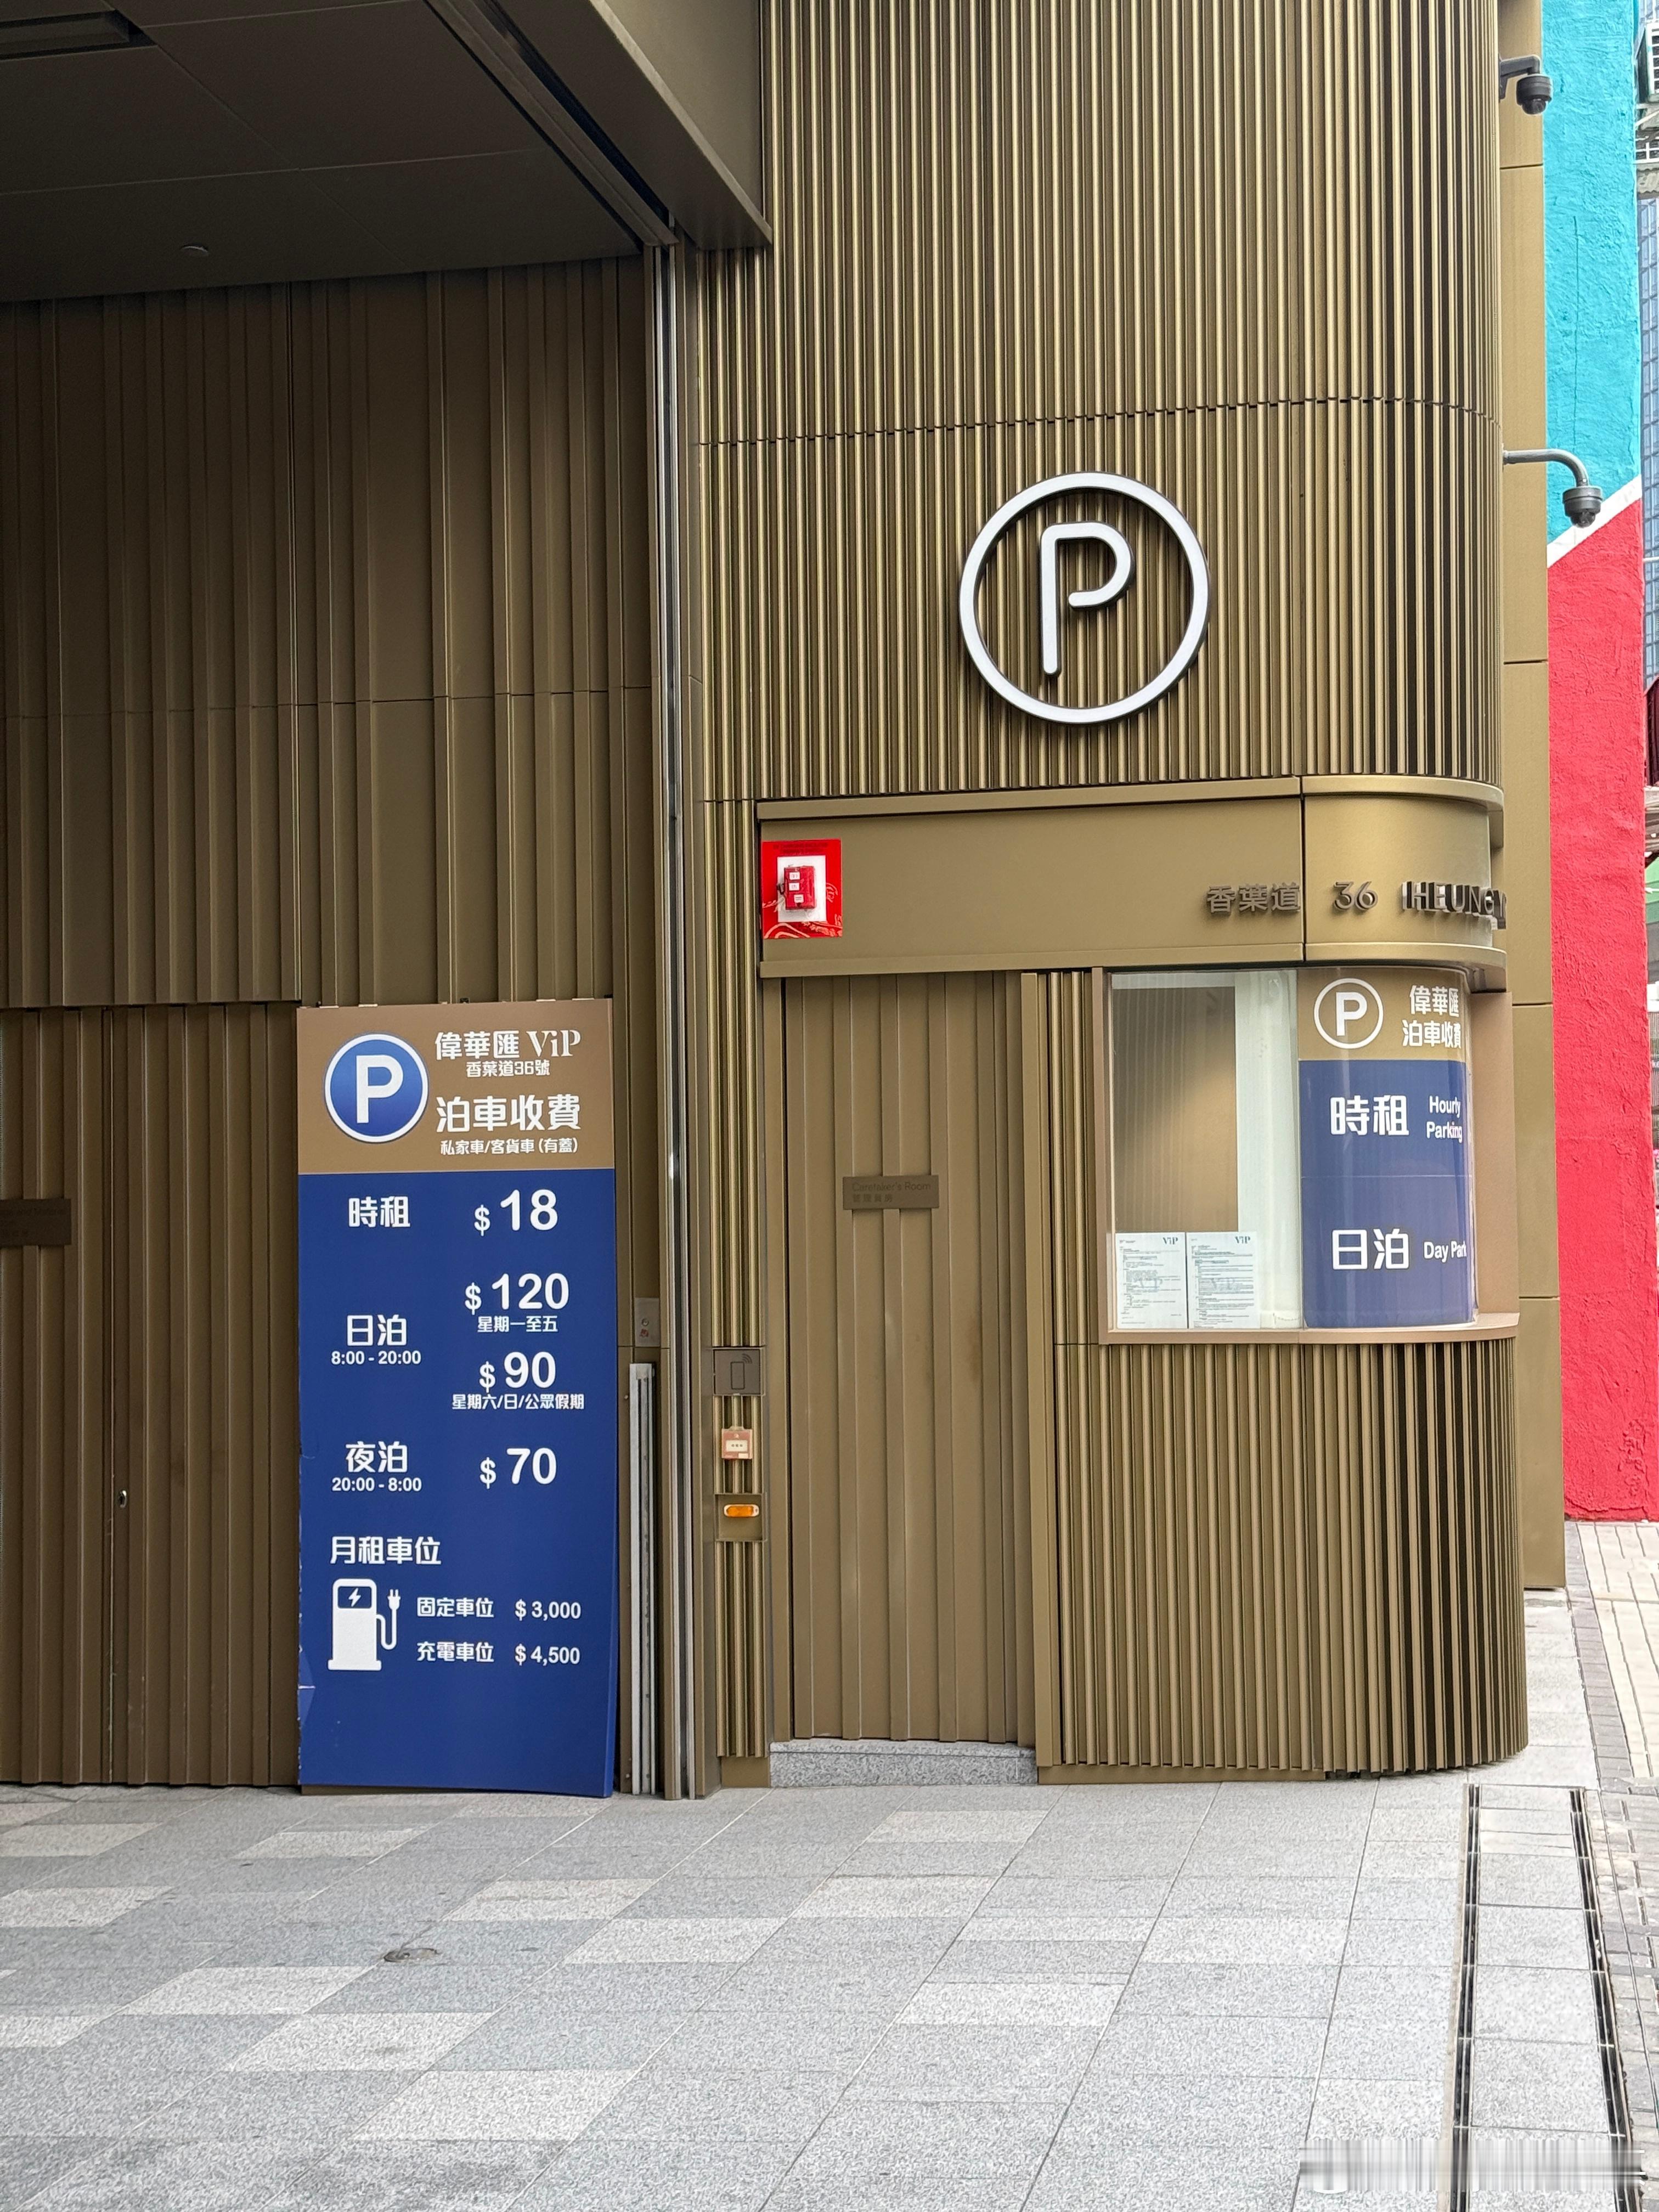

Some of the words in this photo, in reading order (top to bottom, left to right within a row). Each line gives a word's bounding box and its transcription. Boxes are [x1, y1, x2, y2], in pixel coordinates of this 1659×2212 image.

[1207, 882, 1300, 912] 香葉道
[1334, 881, 1379, 911] 36
[1336, 992, 1367, 1036] P
[1409, 985, 1459, 1017] 偉華匯
[435, 1031, 520, 1060] 偉華匯
[1402, 1020, 1461, 1048] 泊車收費
[466, 1059, 550, 1077] 香葉道36號
[356, 1055, 404, 1124] P
[437, 1094, 580, 1132] 泊車收費
[1331, 1095, 1409, 1135] 時租
[1430, 1096, 1460, 1118] Hourly
[1427, 1121, 1462, 1143] Parking
[905, 1182, 931, 1190] Room
[349, 1197, 410, 1227] 時租
[1333, 1229, 1409, 1269] 日泊
[1424, 1242, 1448, 1262] Day
[347, 1314, 406, 1346] 日泊
[478, 1316, 557, 1332] 星期一至五
[453, 1394, 584, 1409] 星期六/日/公眾假期
[346, 1441, 407, 1472] 夜泊
[331, 1537, 441, 1564] 月租車位
[417, 1598, 493, 1617] 固定車位
[417, 1641, 494, 1662] 充電車位
